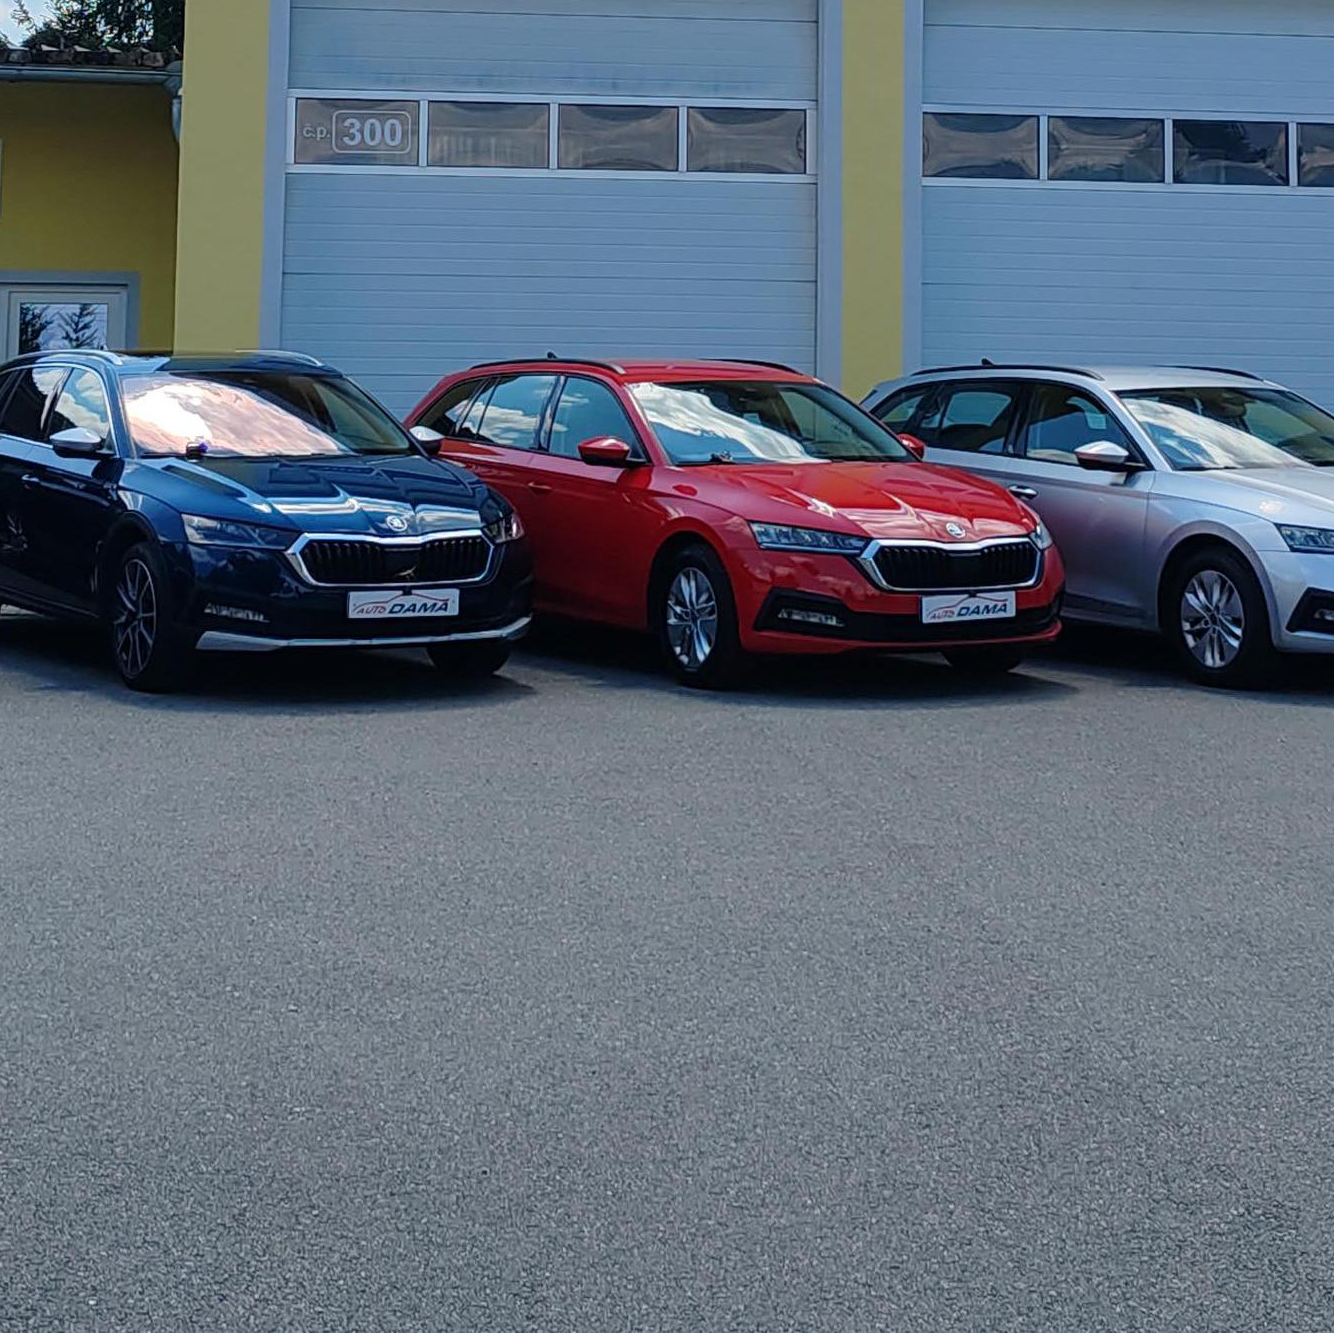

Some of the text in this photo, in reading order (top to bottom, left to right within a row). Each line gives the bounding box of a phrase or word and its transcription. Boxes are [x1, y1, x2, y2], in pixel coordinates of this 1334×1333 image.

[342, 118, 403, 146] 300
[356, 601, 449, 615] AUTO DAMA
[956, 603, 1008, 617] DAMA
